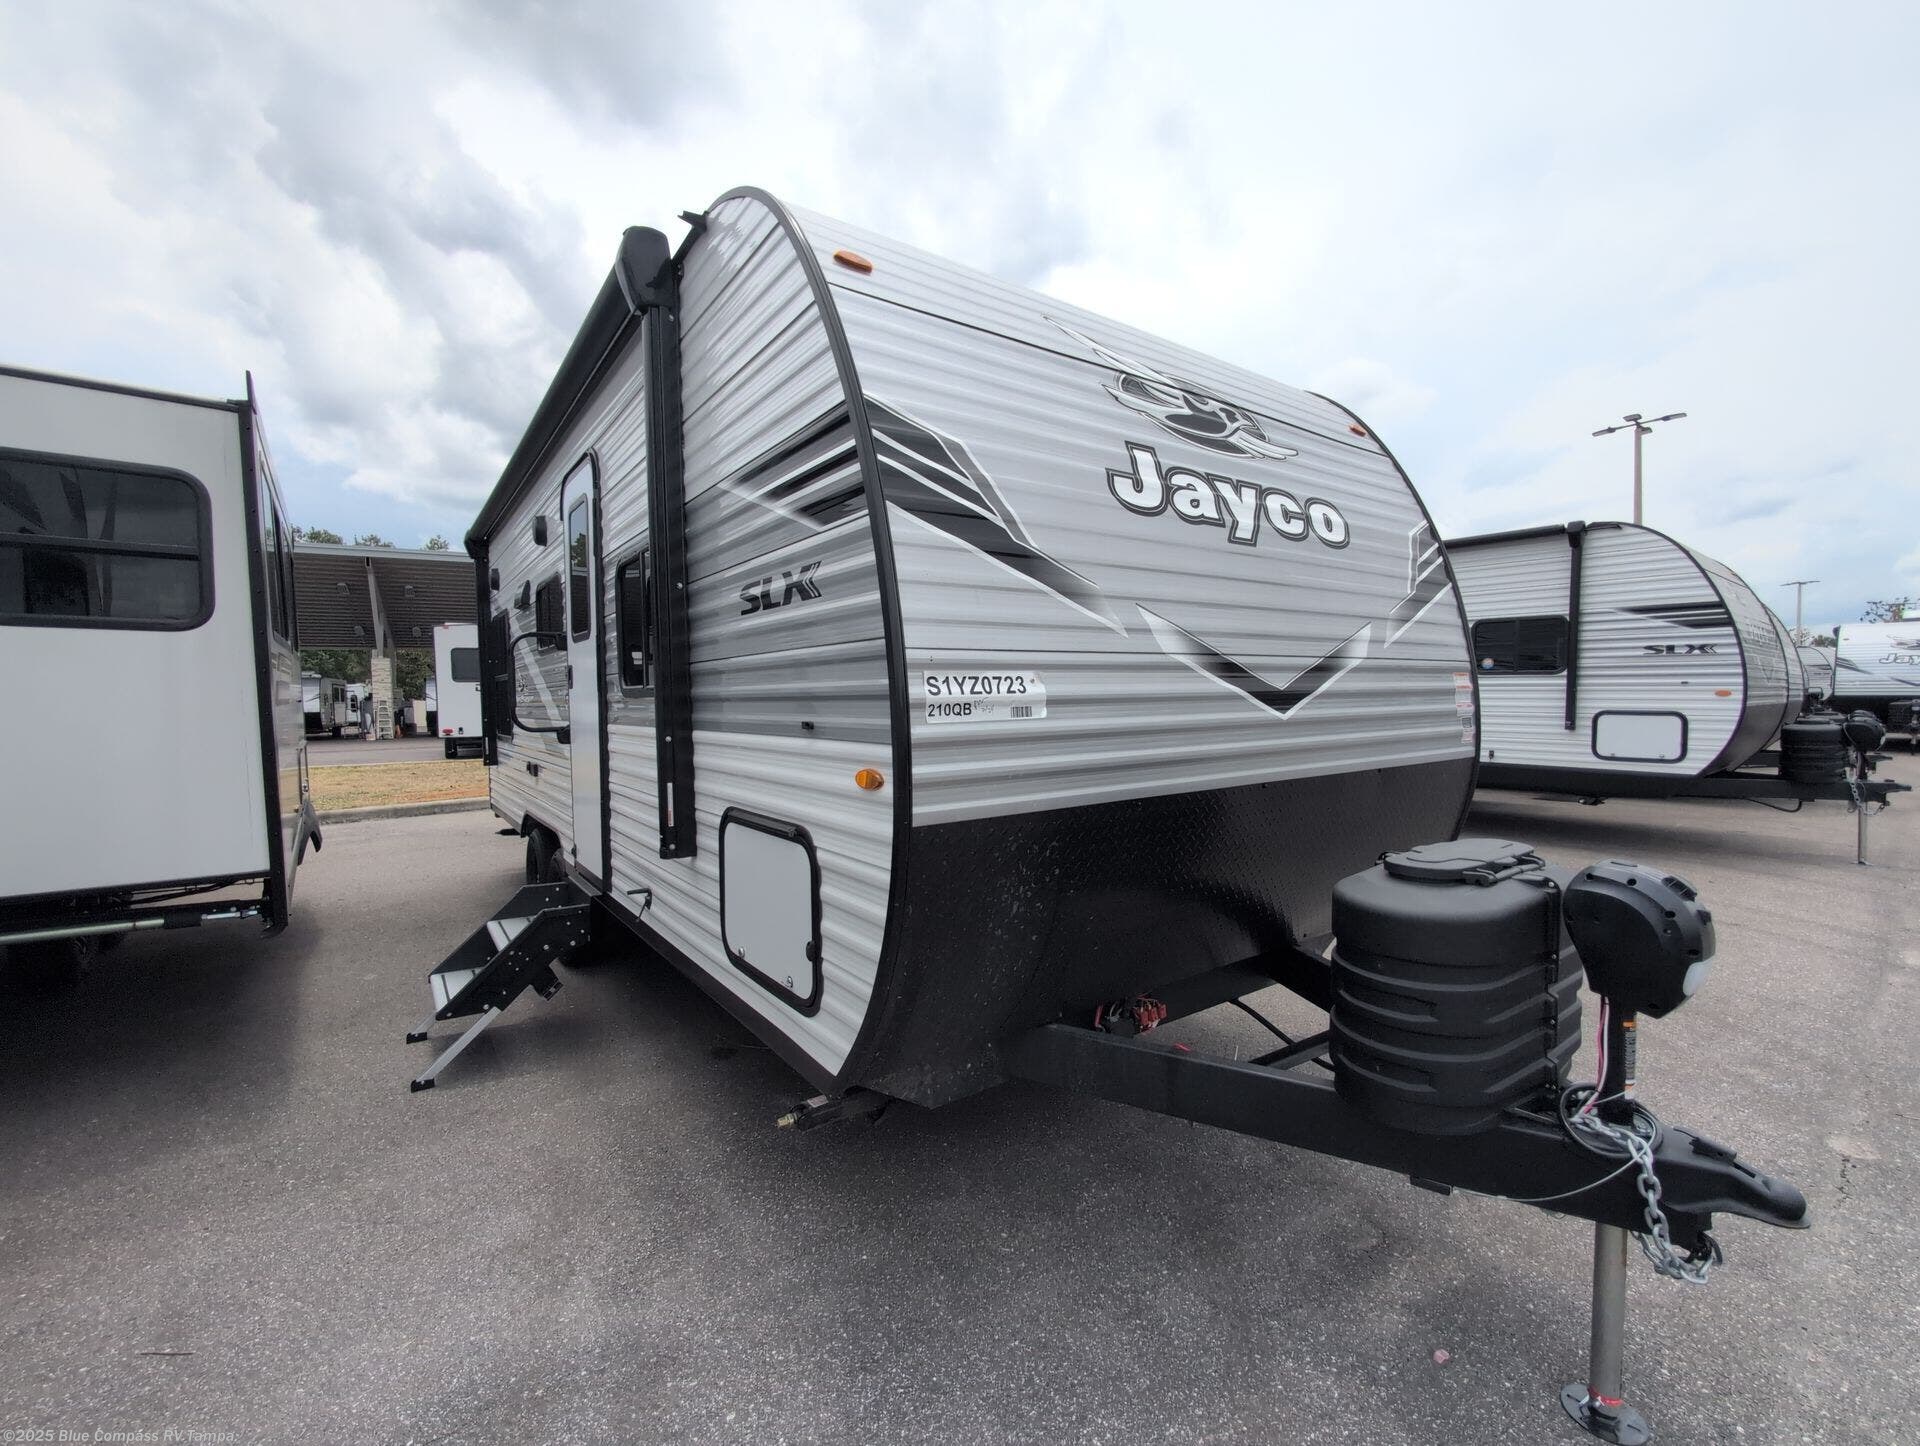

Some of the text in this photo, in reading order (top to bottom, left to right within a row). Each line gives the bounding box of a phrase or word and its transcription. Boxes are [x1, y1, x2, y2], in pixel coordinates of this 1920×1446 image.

[1105, 440, 1350, 550] Jayco
[740, 560, 822, 615] SLX
[1642, 644, 1718, 655] SLX
[926, 675, 1027, 696] S1YZ0723
[928, 702, 972, 717] 210QB
